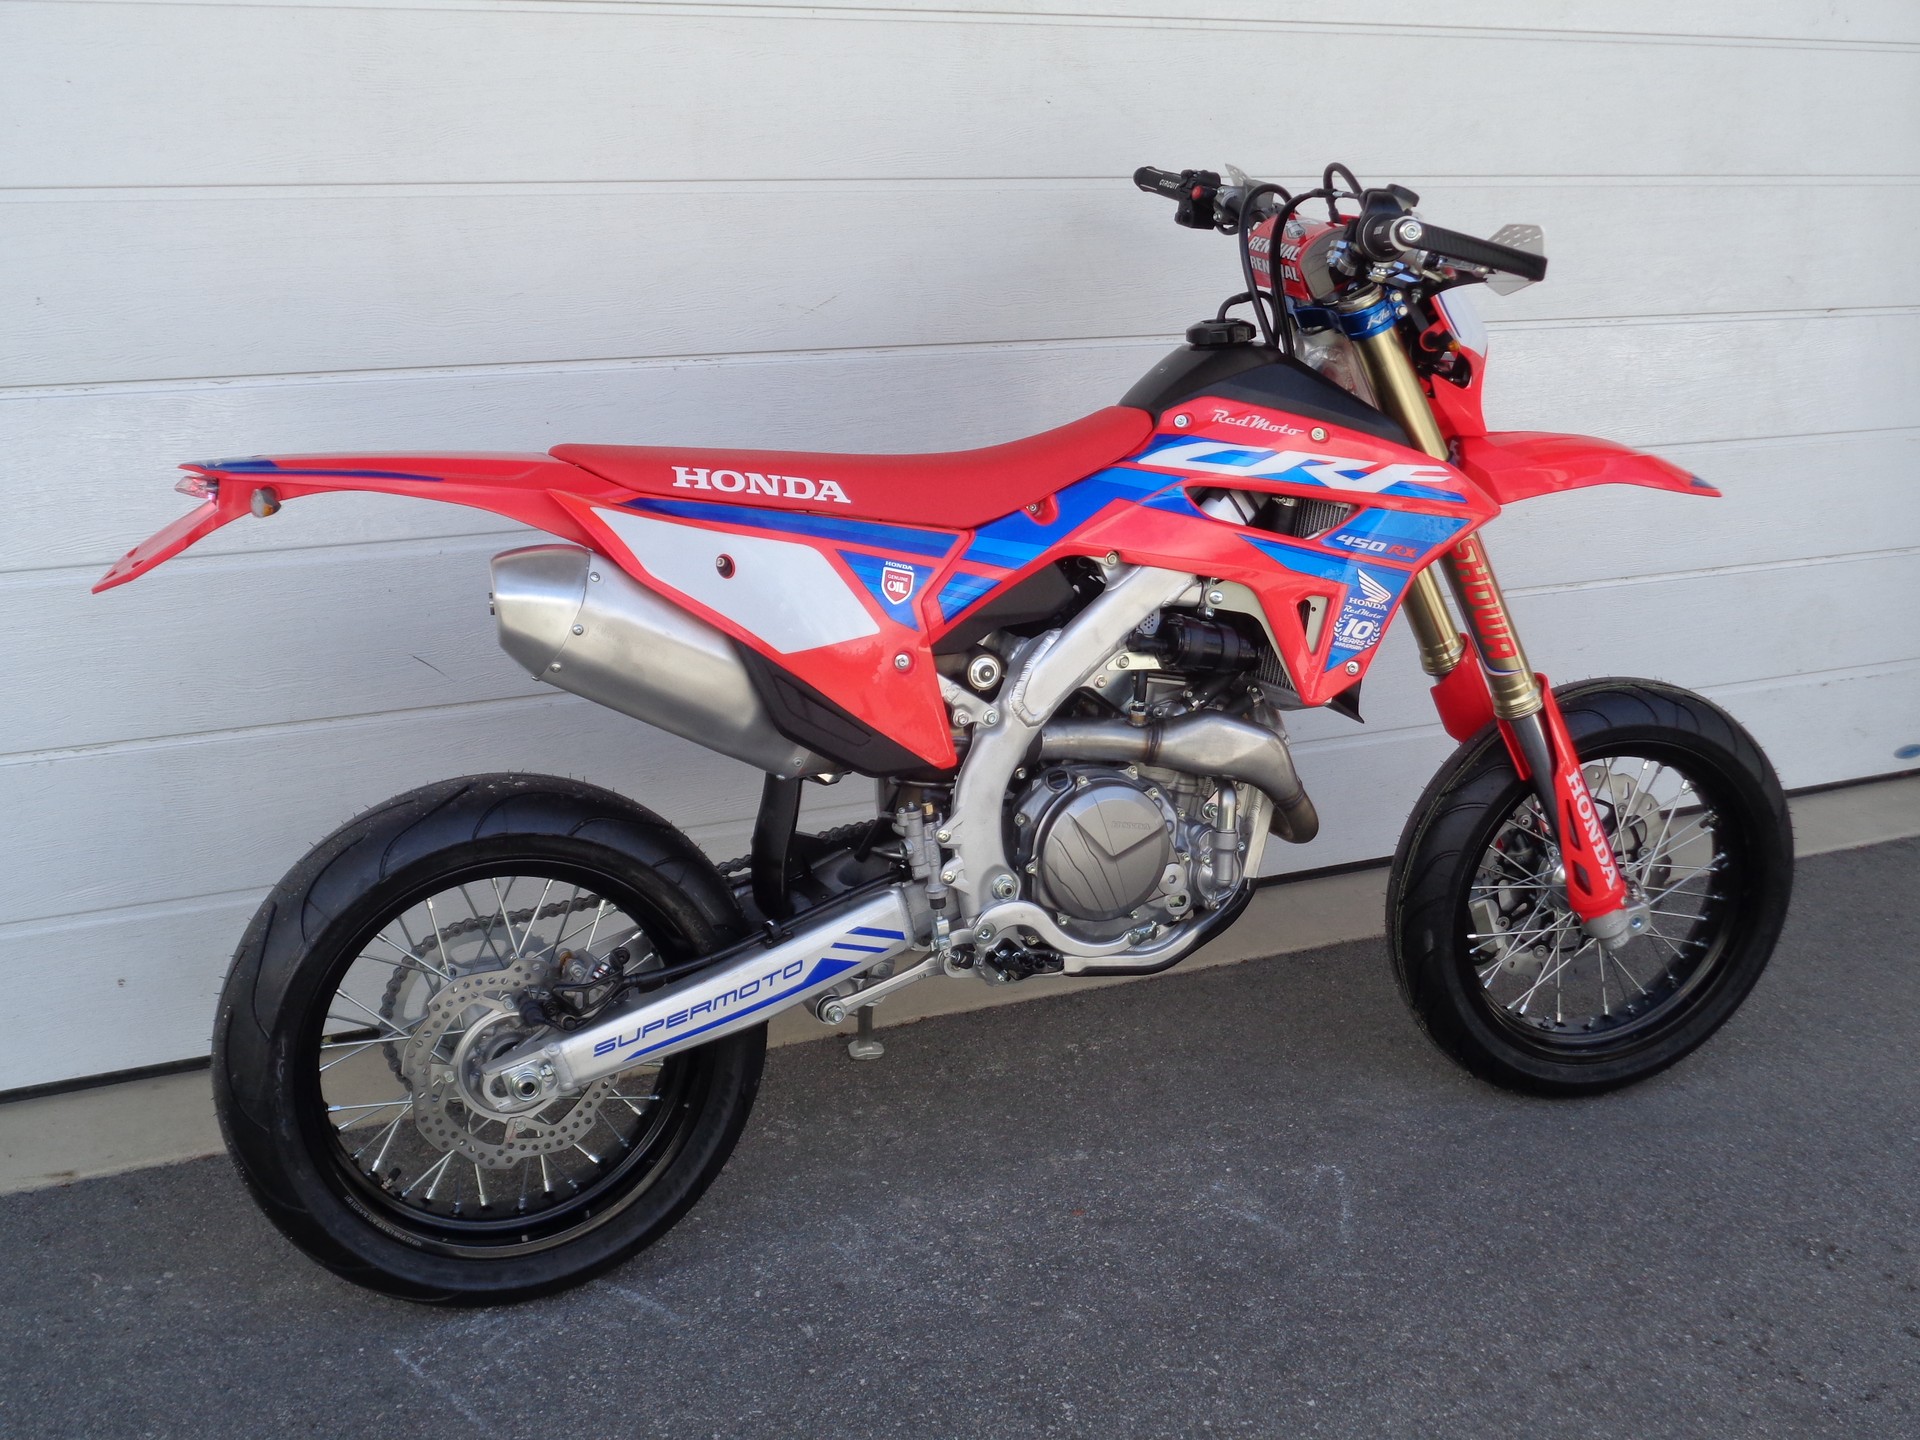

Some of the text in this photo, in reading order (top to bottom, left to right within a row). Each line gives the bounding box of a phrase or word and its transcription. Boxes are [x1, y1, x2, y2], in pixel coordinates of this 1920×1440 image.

[1248, 236, 1301, 261] RENHAL
[1249, 255, 1300, 282] RENAL
[1137, 441, 1453, 493] CRF
[671, 466, 852, 504] HONDA
[1335, 534, 1418, 559] 450 RX
[885, 560, 914, 571] HONDA
[887, 573, 909, 583] GENUINE
[886, 580, 907, 595] OIL
[1450, 537, 1518, 660] SHOWA
[1348, 596, 1388, 612] HONDA
[1338, 635, 1366, 646] YEARS
[1342, 617, 1375, 640] 10
[1565, 767, 1617, 891] HONDA
[593, 959, 804, 1058] SUPERMOTO
